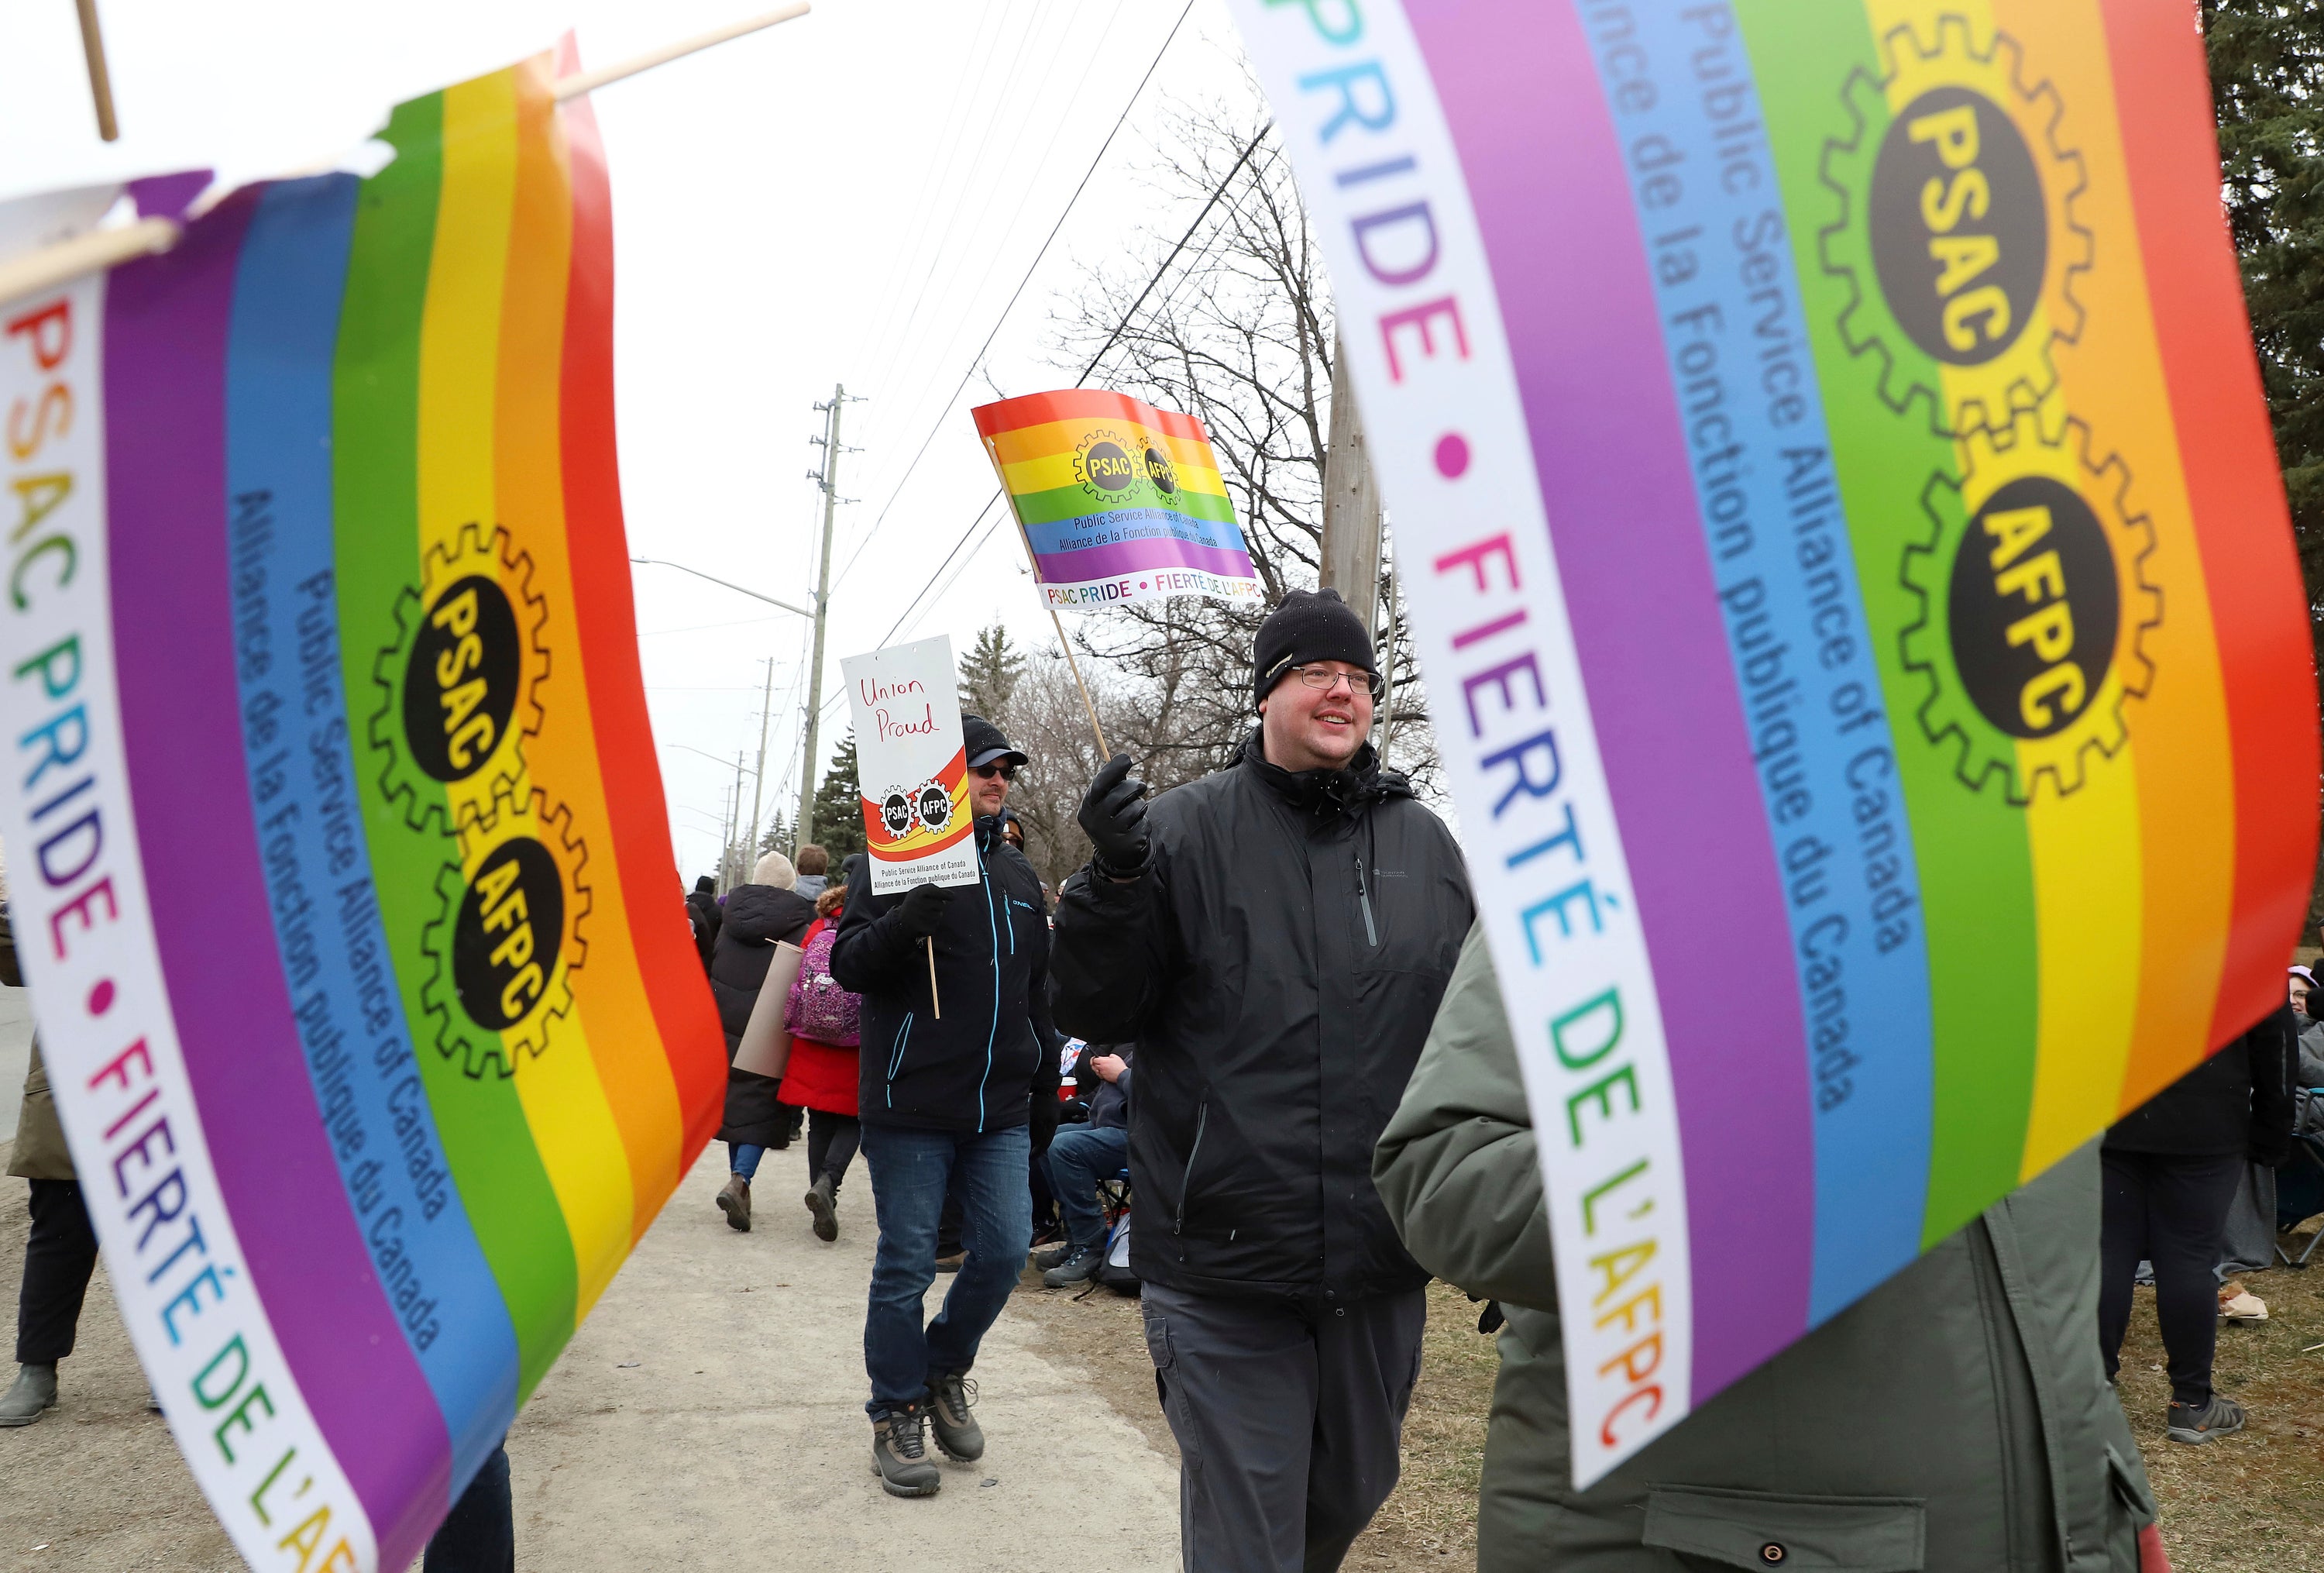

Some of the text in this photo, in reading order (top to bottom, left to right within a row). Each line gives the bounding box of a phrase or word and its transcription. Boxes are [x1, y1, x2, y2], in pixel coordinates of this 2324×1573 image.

[1906, 103, 2088, 731] PSAC AFPC
[1090, 457, 1174, 483] PSAC AFPC
[1680, 2, 1920, 956] Public Service Alliance of Canada
[1059, 525, 1218, 551] Alliance de la Fonction publique du Canada
[1074, 508, 1199, 530] Public Service Alliance of Canada
[1047, 572, 1261, 604] PSAC PRIDE FIERTÉ DE L'AFPC
[1631, 133, 1860, 1114] de la Fonction publique du Canada
[861, 677, 925, 707] Union
[875, 703, 940, 742] Proud
[1263, 0, 1666, 1451] PRIDE FIERTÉ DE L'AFPC
[431, 587, 545, 1021] PSAC AFPC
[886, 798, 947, 821] PSAC AFPC
[874, 880, 893, 889] Alliance
[907, 876, 927, 885] Fonction
[928, 873, 951, 883] publique
[958, 870, 976, 879] Canada
[882, 860, 966, 877] Public Service Alliance of Canada
[295, 566, 449, 1223] Public Service Alliance of Canada
[5, 298, 358, 1573] PSAC PRIDE FIERTÉ DE L'AF
[234, 487, 442, 1353] Alliance de la Fonction publique du Canada
